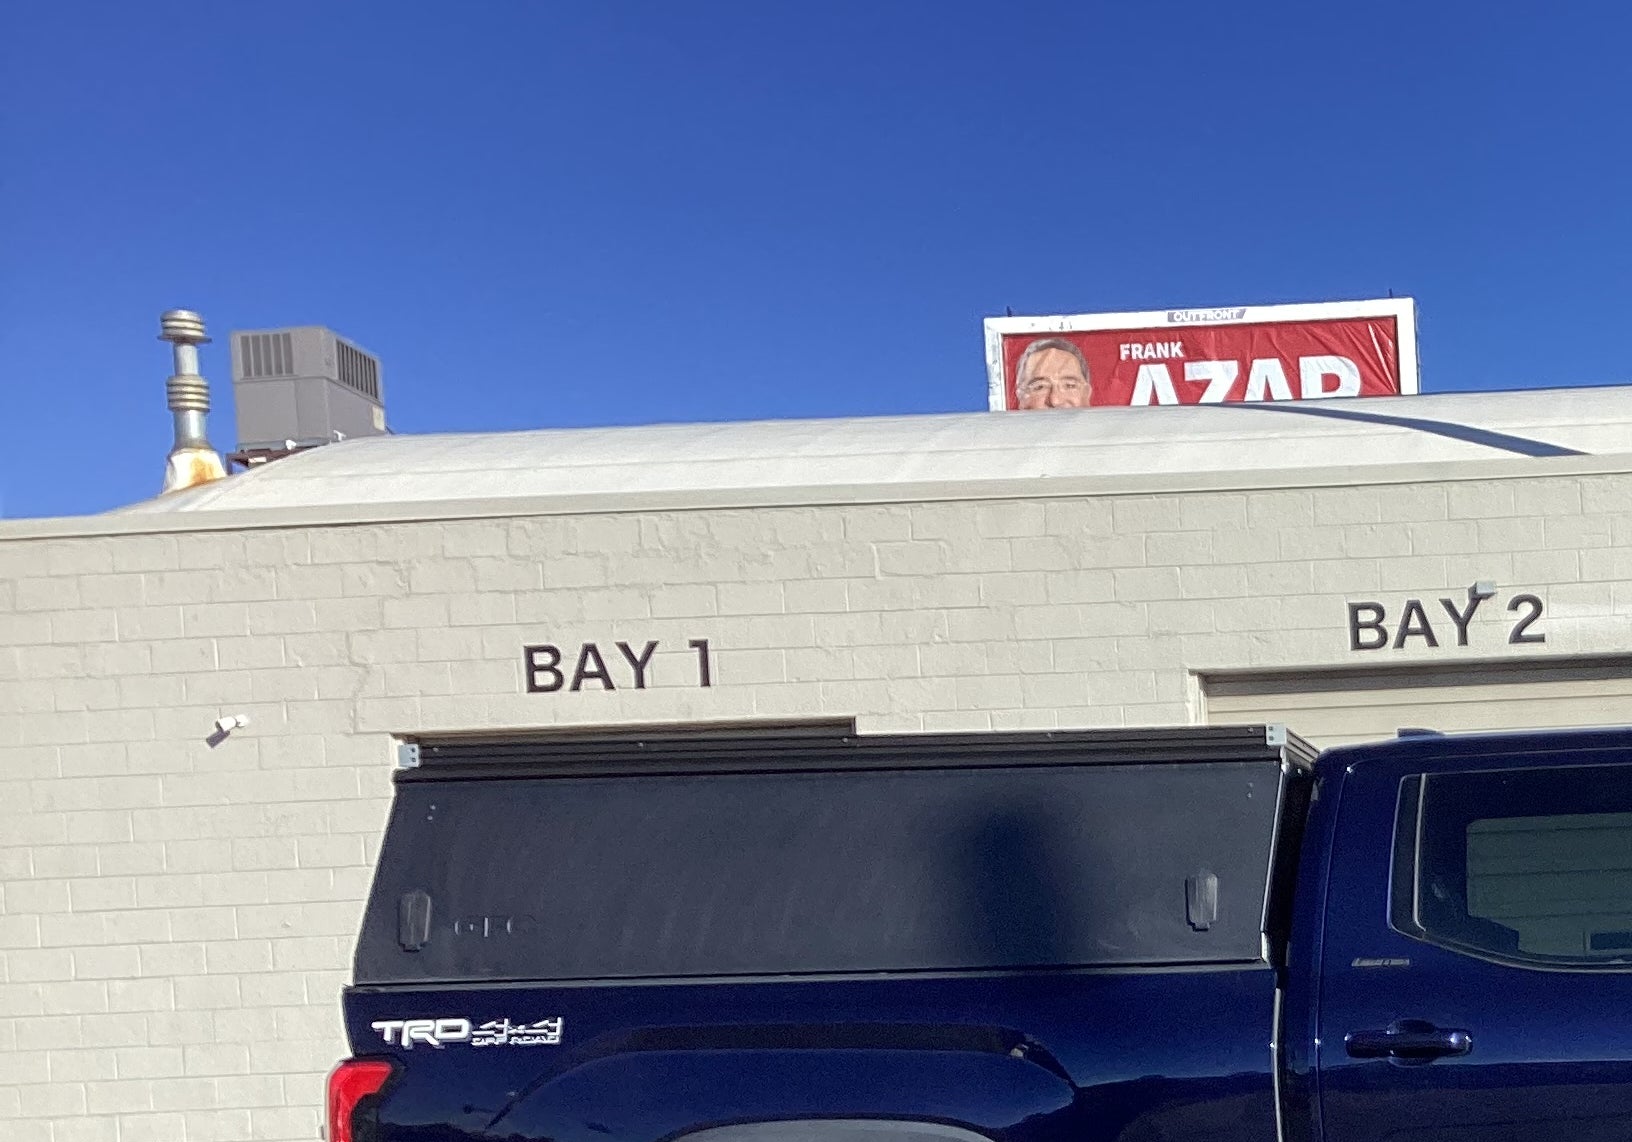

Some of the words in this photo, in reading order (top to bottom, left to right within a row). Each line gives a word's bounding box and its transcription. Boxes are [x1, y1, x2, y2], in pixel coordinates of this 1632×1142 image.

[1173, 308, 1240, 321] OUTFRONT
[1120, 341, 1185, 361] FRANK
[1348, 598, 1482, 650] BAY
[1507, 594, 1546, 644] 2
[523, 640, 660, 693] BAY
[688, 639, 711, 688] 1
[371, 1018, 473, 1048] TRD
